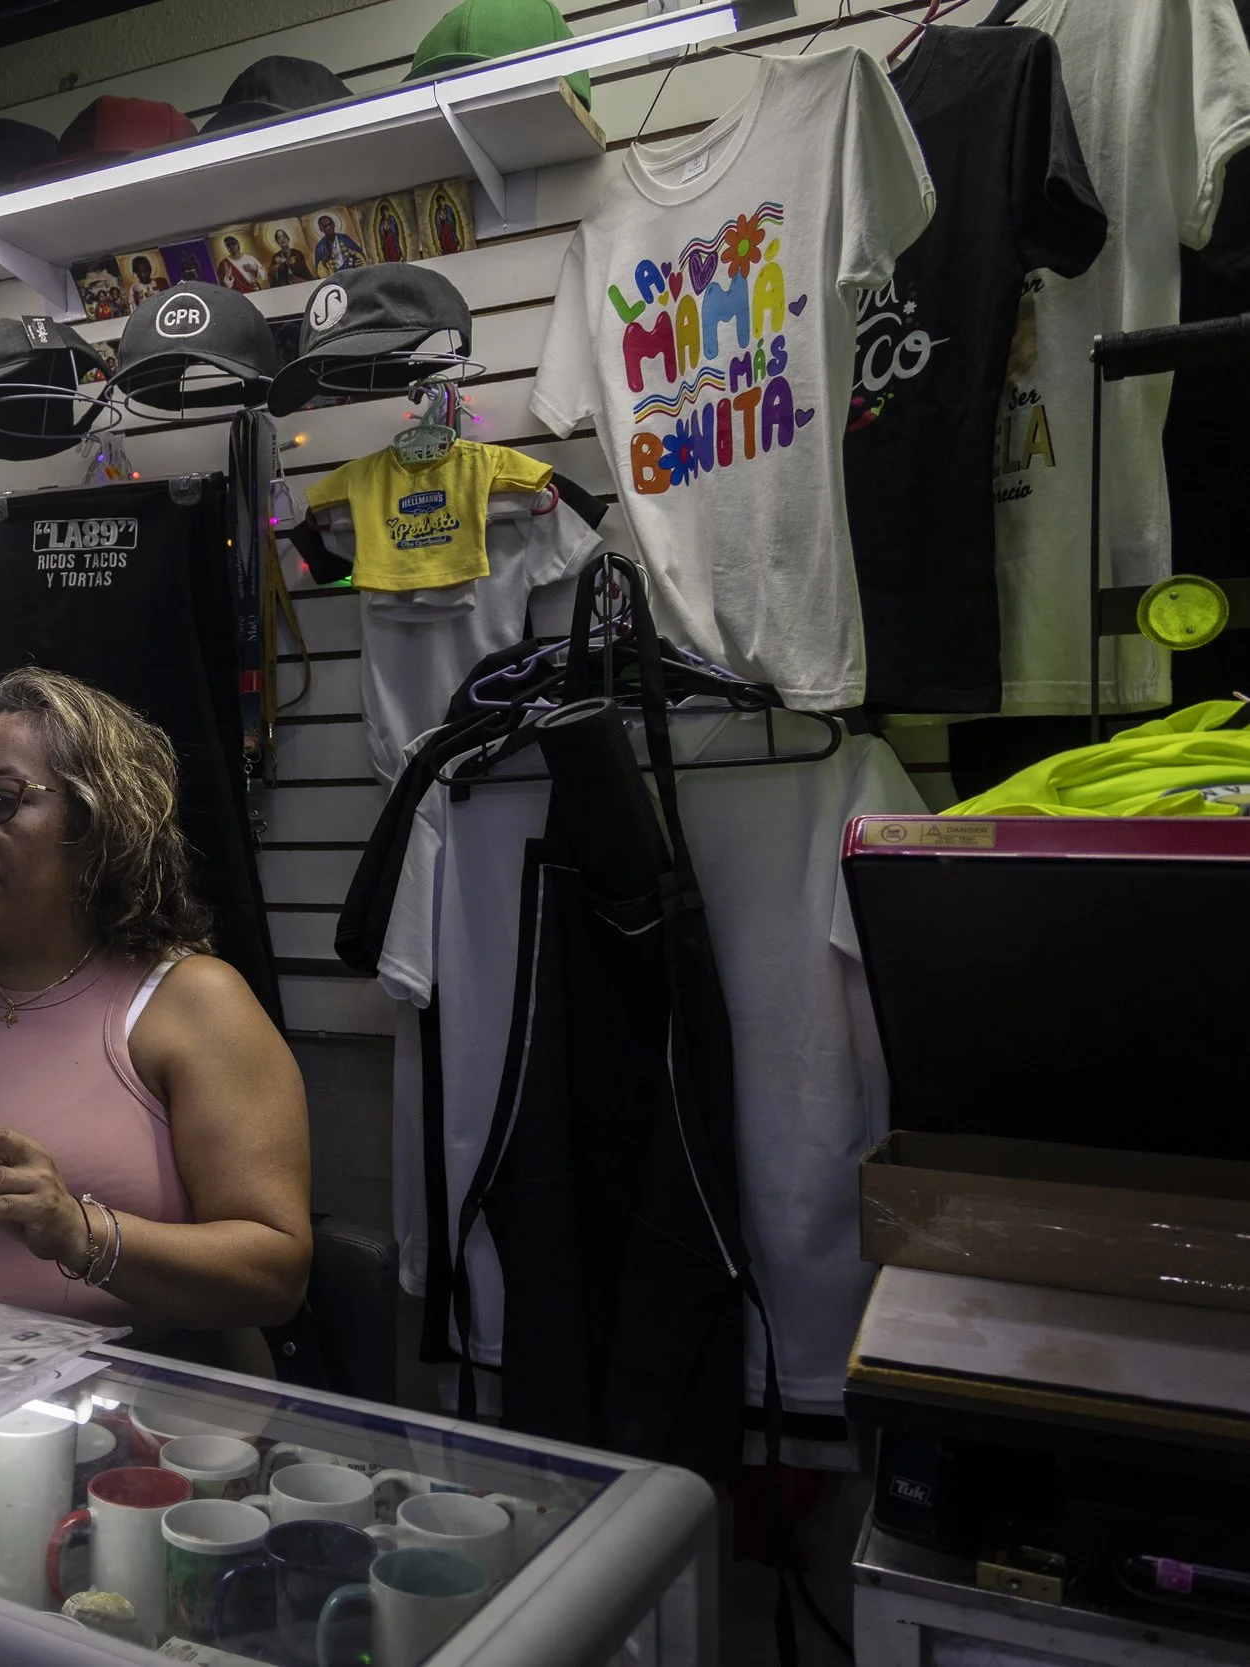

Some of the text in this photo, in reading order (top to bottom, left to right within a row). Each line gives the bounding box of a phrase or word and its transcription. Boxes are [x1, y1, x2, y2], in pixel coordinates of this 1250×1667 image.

[607, 259, 664, 324] LA
[164, 309, 201, 327] CPR
[622, 238, 786, 393] MAMÁ
[729, 334, 788, 393] MÁS
[1008, 387, 1041, 411] Ser
[401, 493, 444, 509] HELLMANN'S
[37, 552, 128, 570] RICOS TACOS
[46, 571, 113, 588] Y TORTAS
[896, 1479, 926, 1501] Tuk
